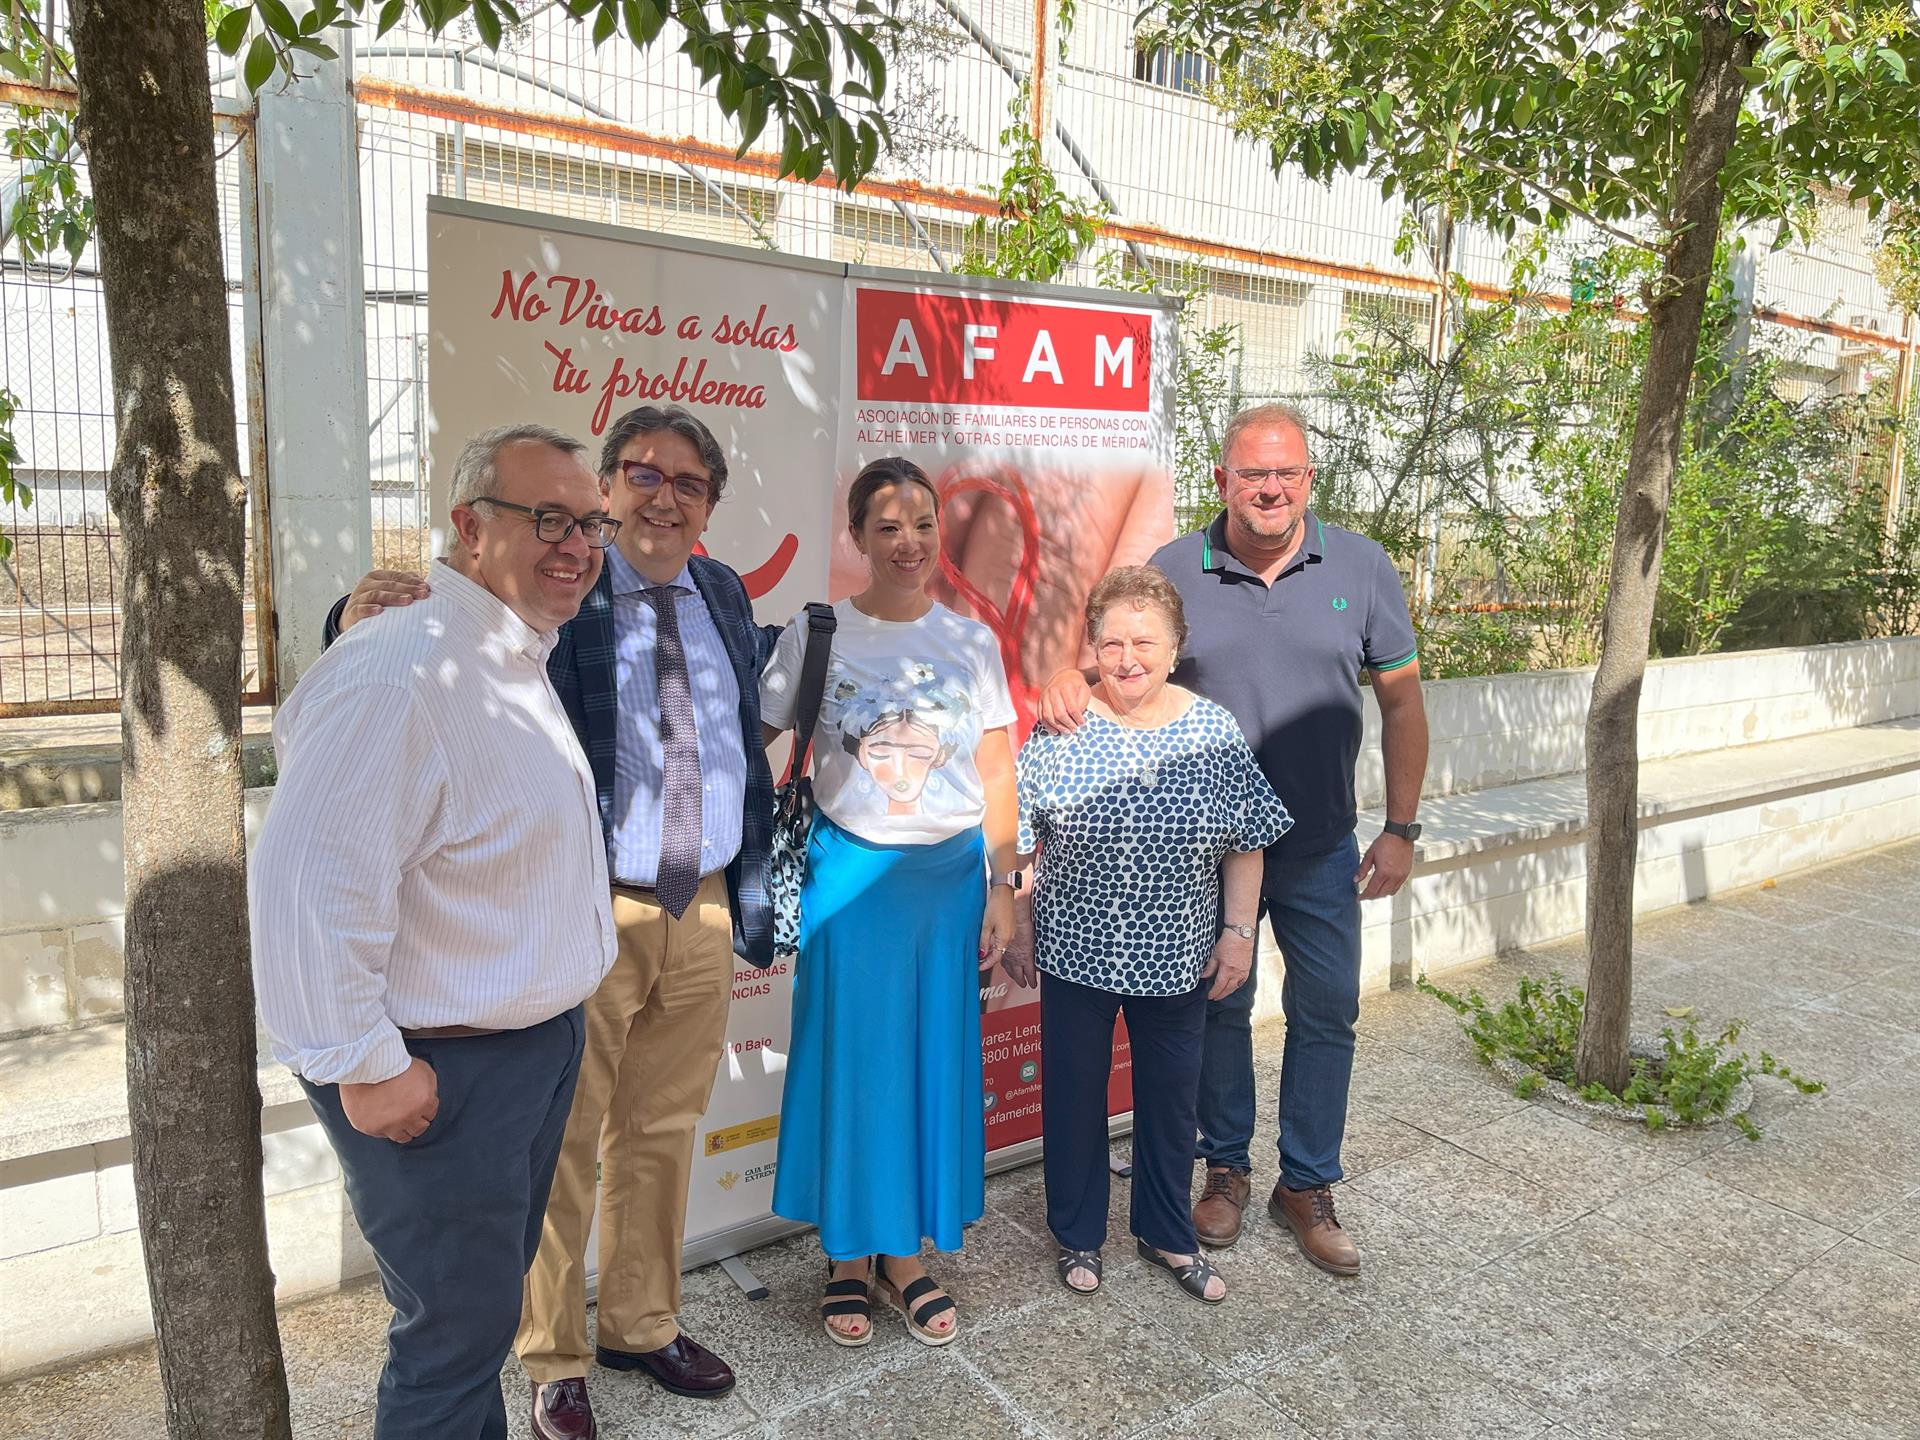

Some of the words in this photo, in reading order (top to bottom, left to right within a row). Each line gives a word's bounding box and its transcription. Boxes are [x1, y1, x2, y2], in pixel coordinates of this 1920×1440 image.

[491, 269, 552, 323] No
[547, 275, 666, 337] Vivas
[677, 314, 703, 341] a
[711, 304, 800, 353] solas
[880, 318, 1134, 389] AFAM
[544, 340, 592, 393] tu
[591, 356, 767, 436] problema
[857, 408, 939, 425] ASOCIACIÓN
[943, 412, 961, 426] DE
[964, 412, 1037, 428] FAMILIARES
[1040, 415, 1057, 429] DE
[1060, 416, 1120, 431] PERSONAS
[1122, 418, 1148, 432] CON
[857, 429, 937, 444] ALZHEIMER
[941, 431, 951, 444] Y
[954, 431, 1001, 446] OTRAS
[1005, 433, 1078, 448] DEMENCIAS
[1082, 435, 1098, 449] DE
[1102, 434, 1148, 449] MÉRIDA
[731, 983, 770, 1000] NCIAS
[984, 1102, 1042, 1127] .afamerida
